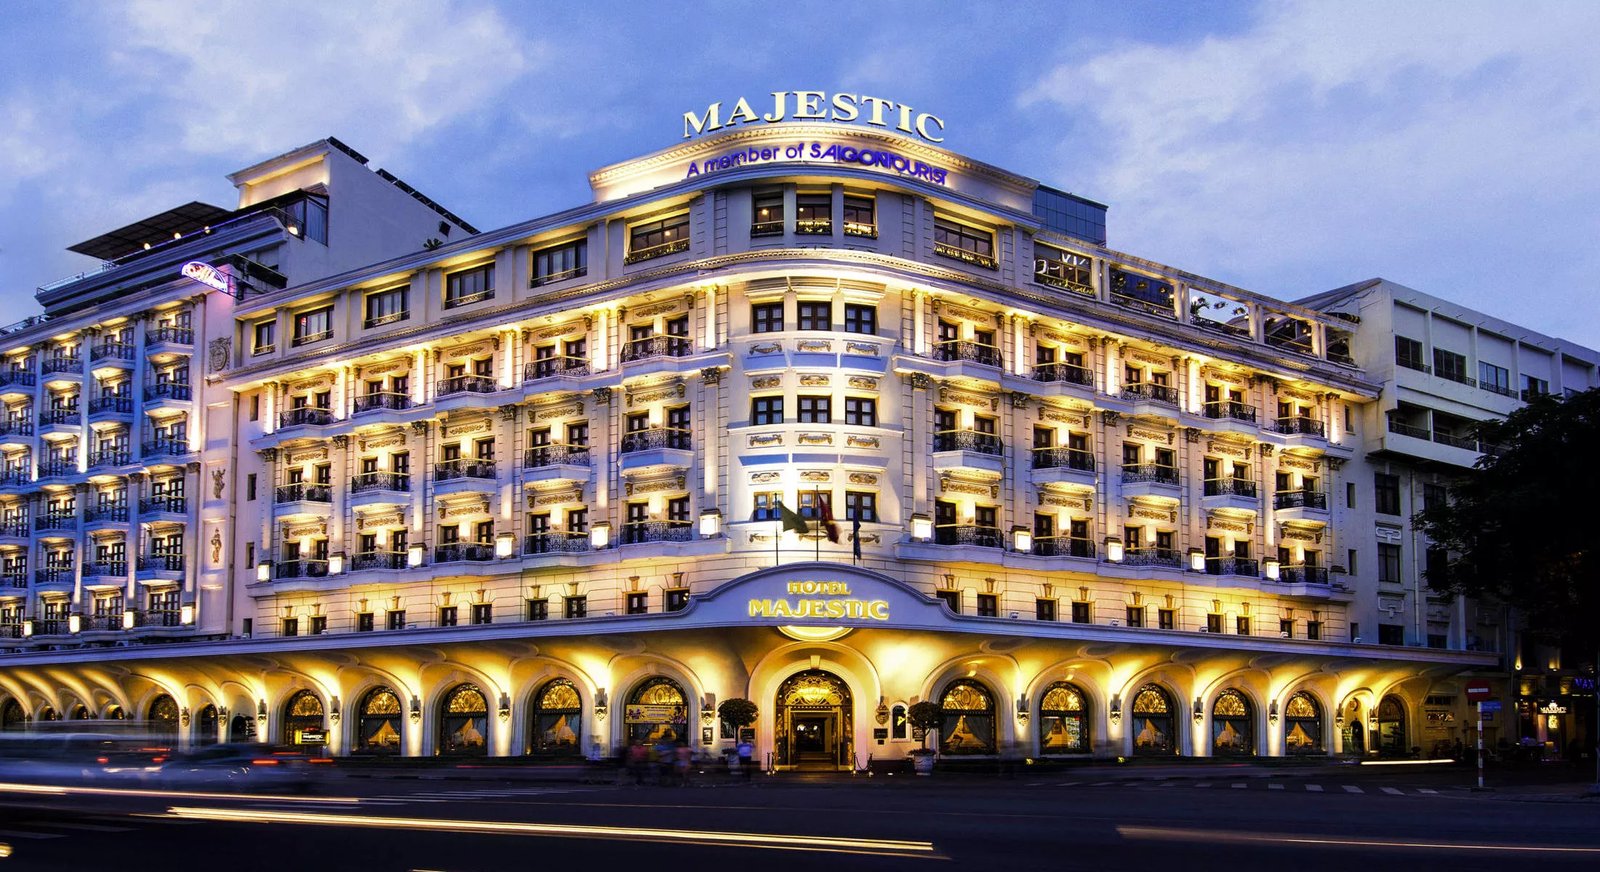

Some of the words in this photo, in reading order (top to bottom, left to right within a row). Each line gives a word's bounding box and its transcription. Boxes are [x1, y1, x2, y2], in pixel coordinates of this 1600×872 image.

[682, 90, 945, 143] MAJESTIC
[686, 161, 700, 179] A
[704, 147, 780, 174] member
[785, 142, 805, 159] of
[809, 142, 948, 185] SAIGONTOURIST
[787, 580, 851, 595] HOTEL
[748, 598, 890, 621] MAJESTIC
